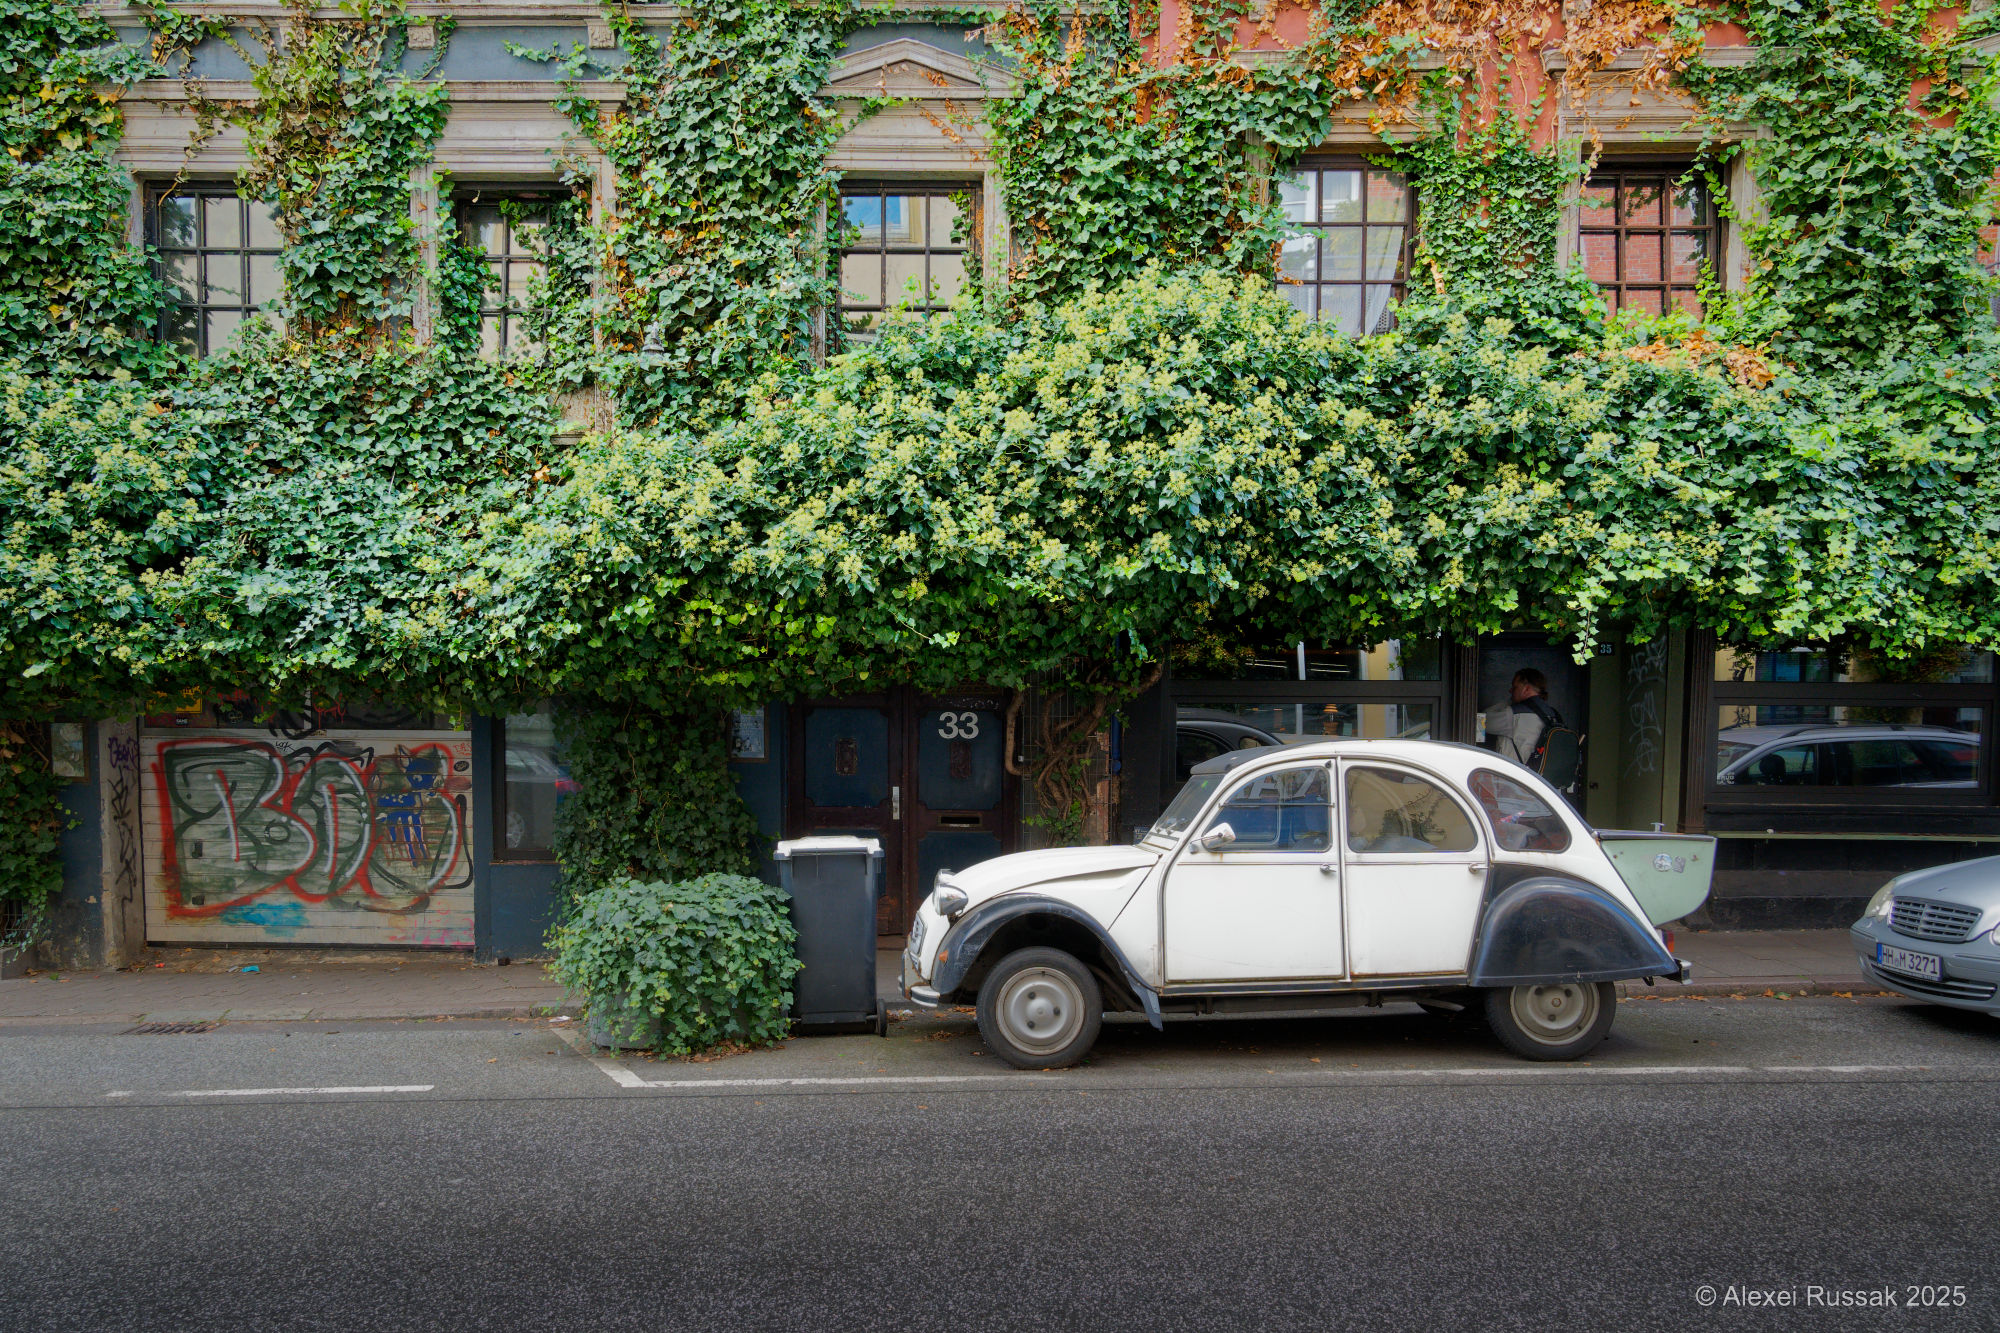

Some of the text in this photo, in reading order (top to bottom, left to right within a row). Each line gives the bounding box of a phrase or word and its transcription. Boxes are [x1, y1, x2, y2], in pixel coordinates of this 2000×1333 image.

[1600, 643, 1612, 654] 35
[938, 711, 979, 739] 33
[1908, 953, 1938, 975] 3271
